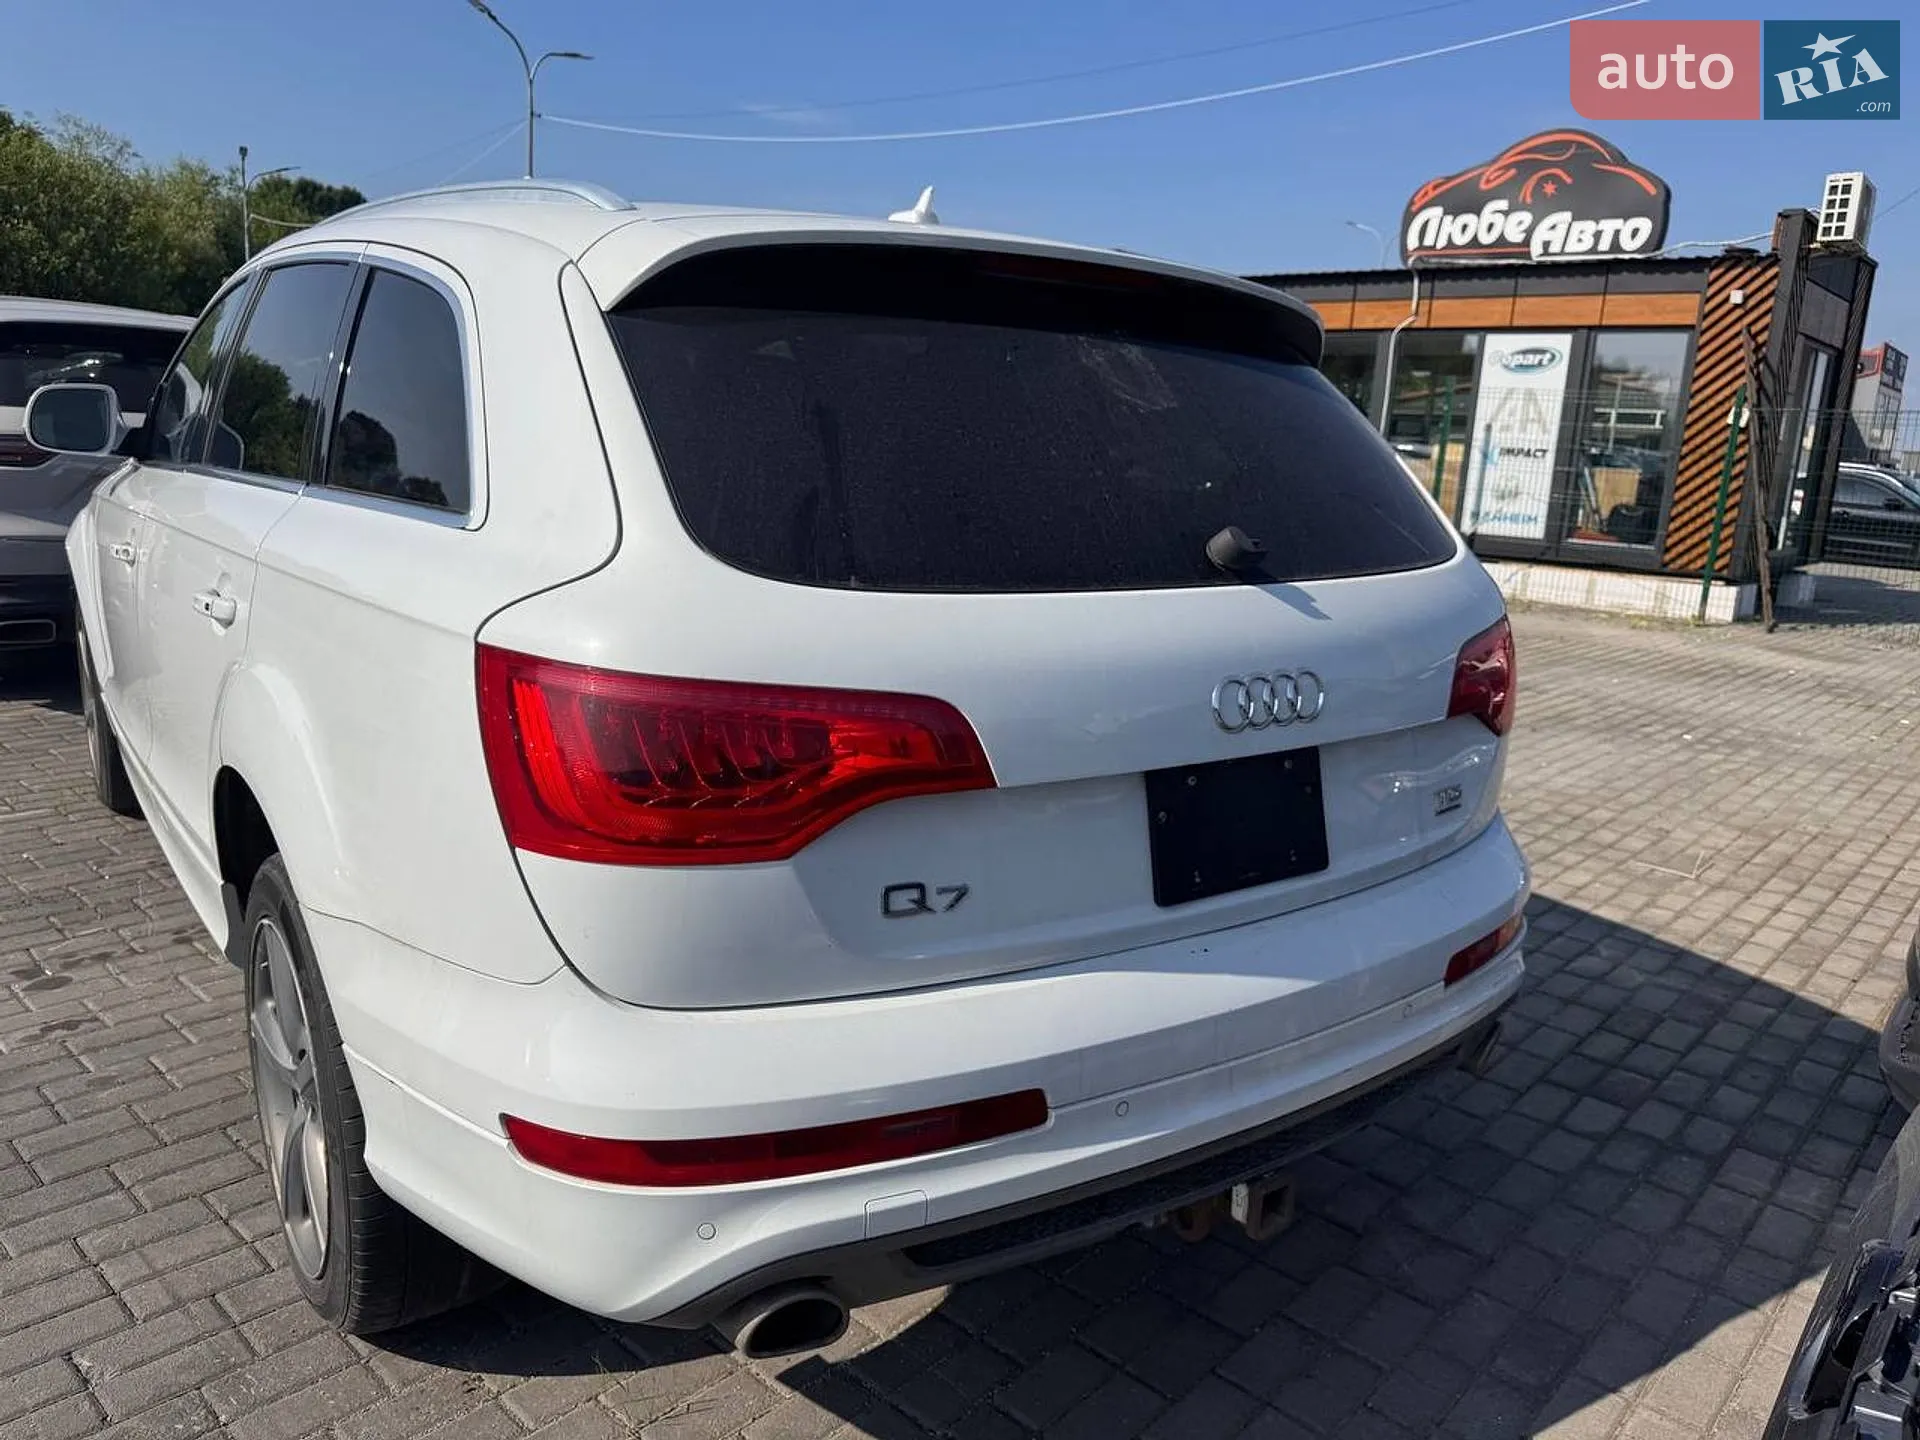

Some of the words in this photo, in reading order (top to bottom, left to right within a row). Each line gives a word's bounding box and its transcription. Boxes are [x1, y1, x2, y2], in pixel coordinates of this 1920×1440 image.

[1406, 199, 1534, 251] Любе
[1529, 211, 1653, 261] Авто
[881, 881, 970, 919] Q7
